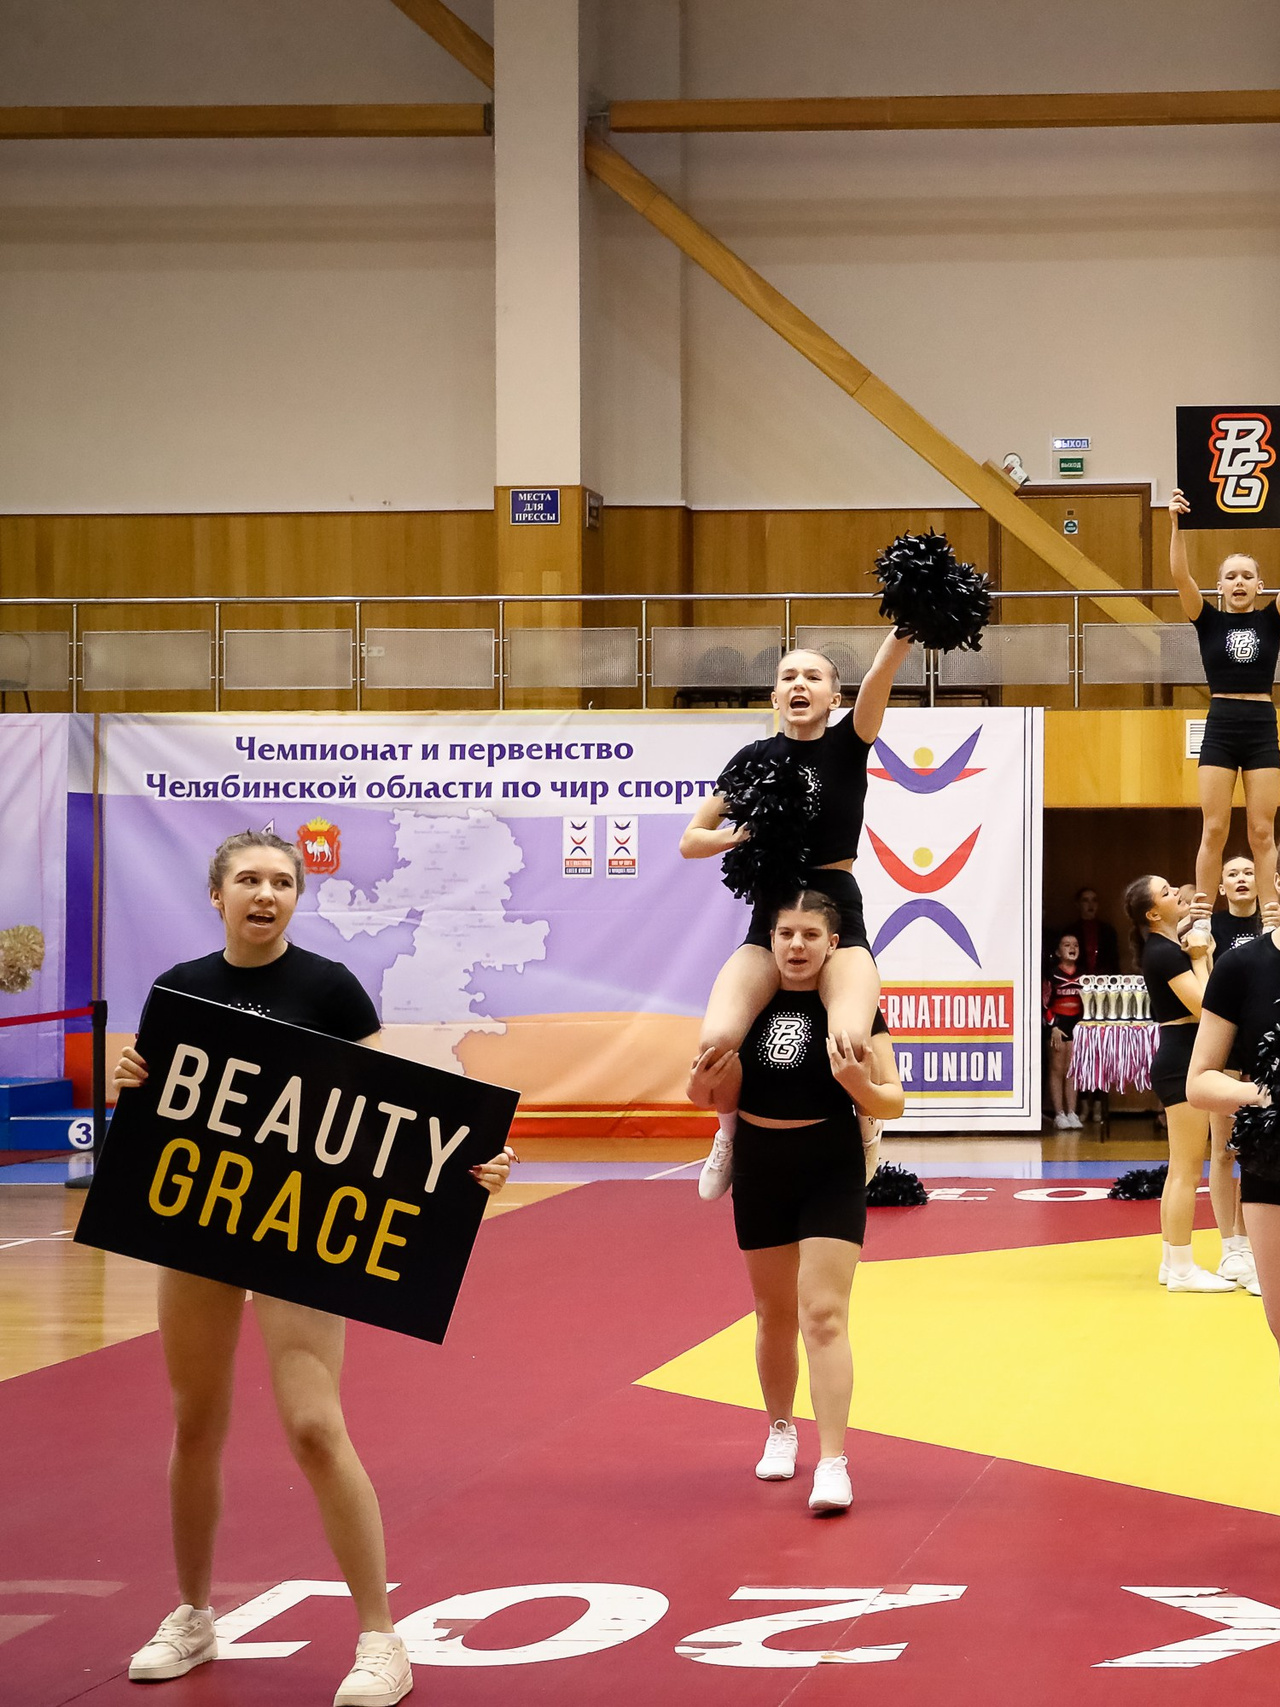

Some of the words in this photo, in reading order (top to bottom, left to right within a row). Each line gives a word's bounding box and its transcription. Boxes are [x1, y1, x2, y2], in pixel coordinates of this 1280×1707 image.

[1054, 439, 1088, 449] ЫХОД
[1061, 461, 1082, 469] ВЫХОД
[518, 493, 552, 501] МЕСТА
[523, 503, 544, 512] ДЛЯ
[515, 513, 556, 521] ПРЕССЫ
[236, 736, 413, 761] Чемпионат
[421, 743, 439, 761] и
[449, 743, 634, 768] первенство
[146, 773, 357, 799] Челябинской
[366, 774, 493, 799] области
[502, 781, 541, 798] по
[550, 781, 609, 805] чир
[923, 1051, 1003, 1082] UNION
[156, 1042, 471, 1194] BEAUTY
[75, 1122, 92, 1145] 3
[148, 1137, 422, 1283] GRACE
